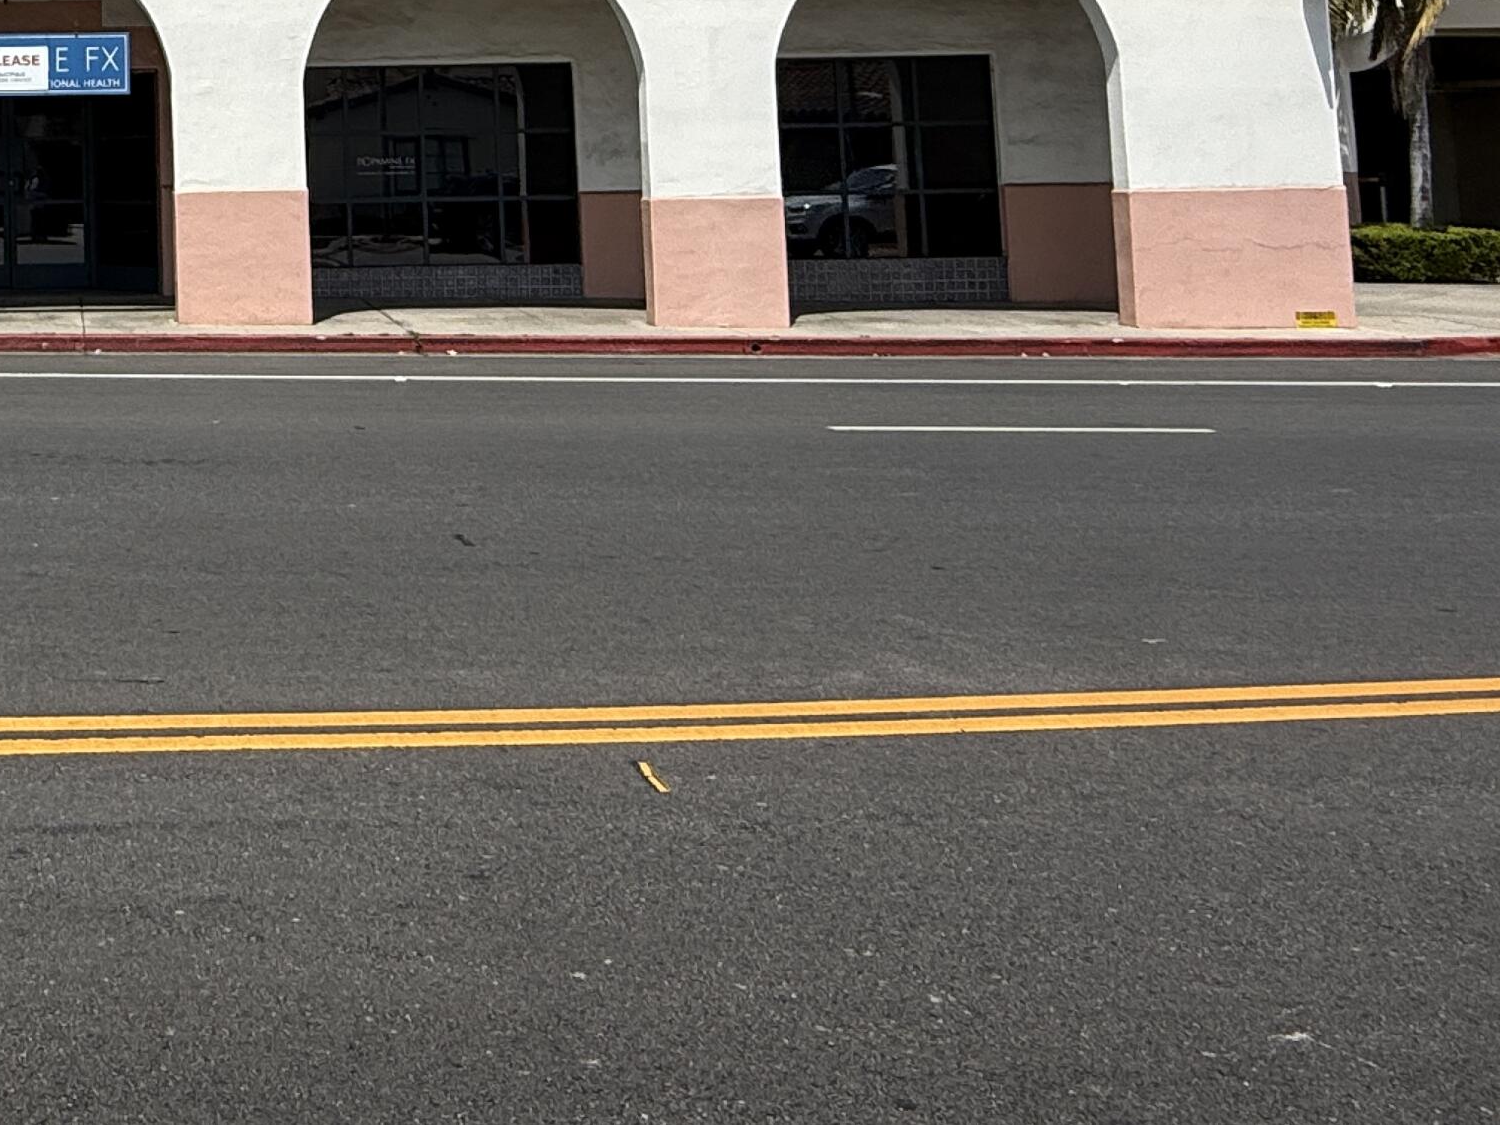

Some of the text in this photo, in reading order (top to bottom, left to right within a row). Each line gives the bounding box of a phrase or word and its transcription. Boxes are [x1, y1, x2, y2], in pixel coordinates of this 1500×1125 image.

[86, 46, 120, 73] FX
[50, 77, 121, 89] IONAL HEALTH
